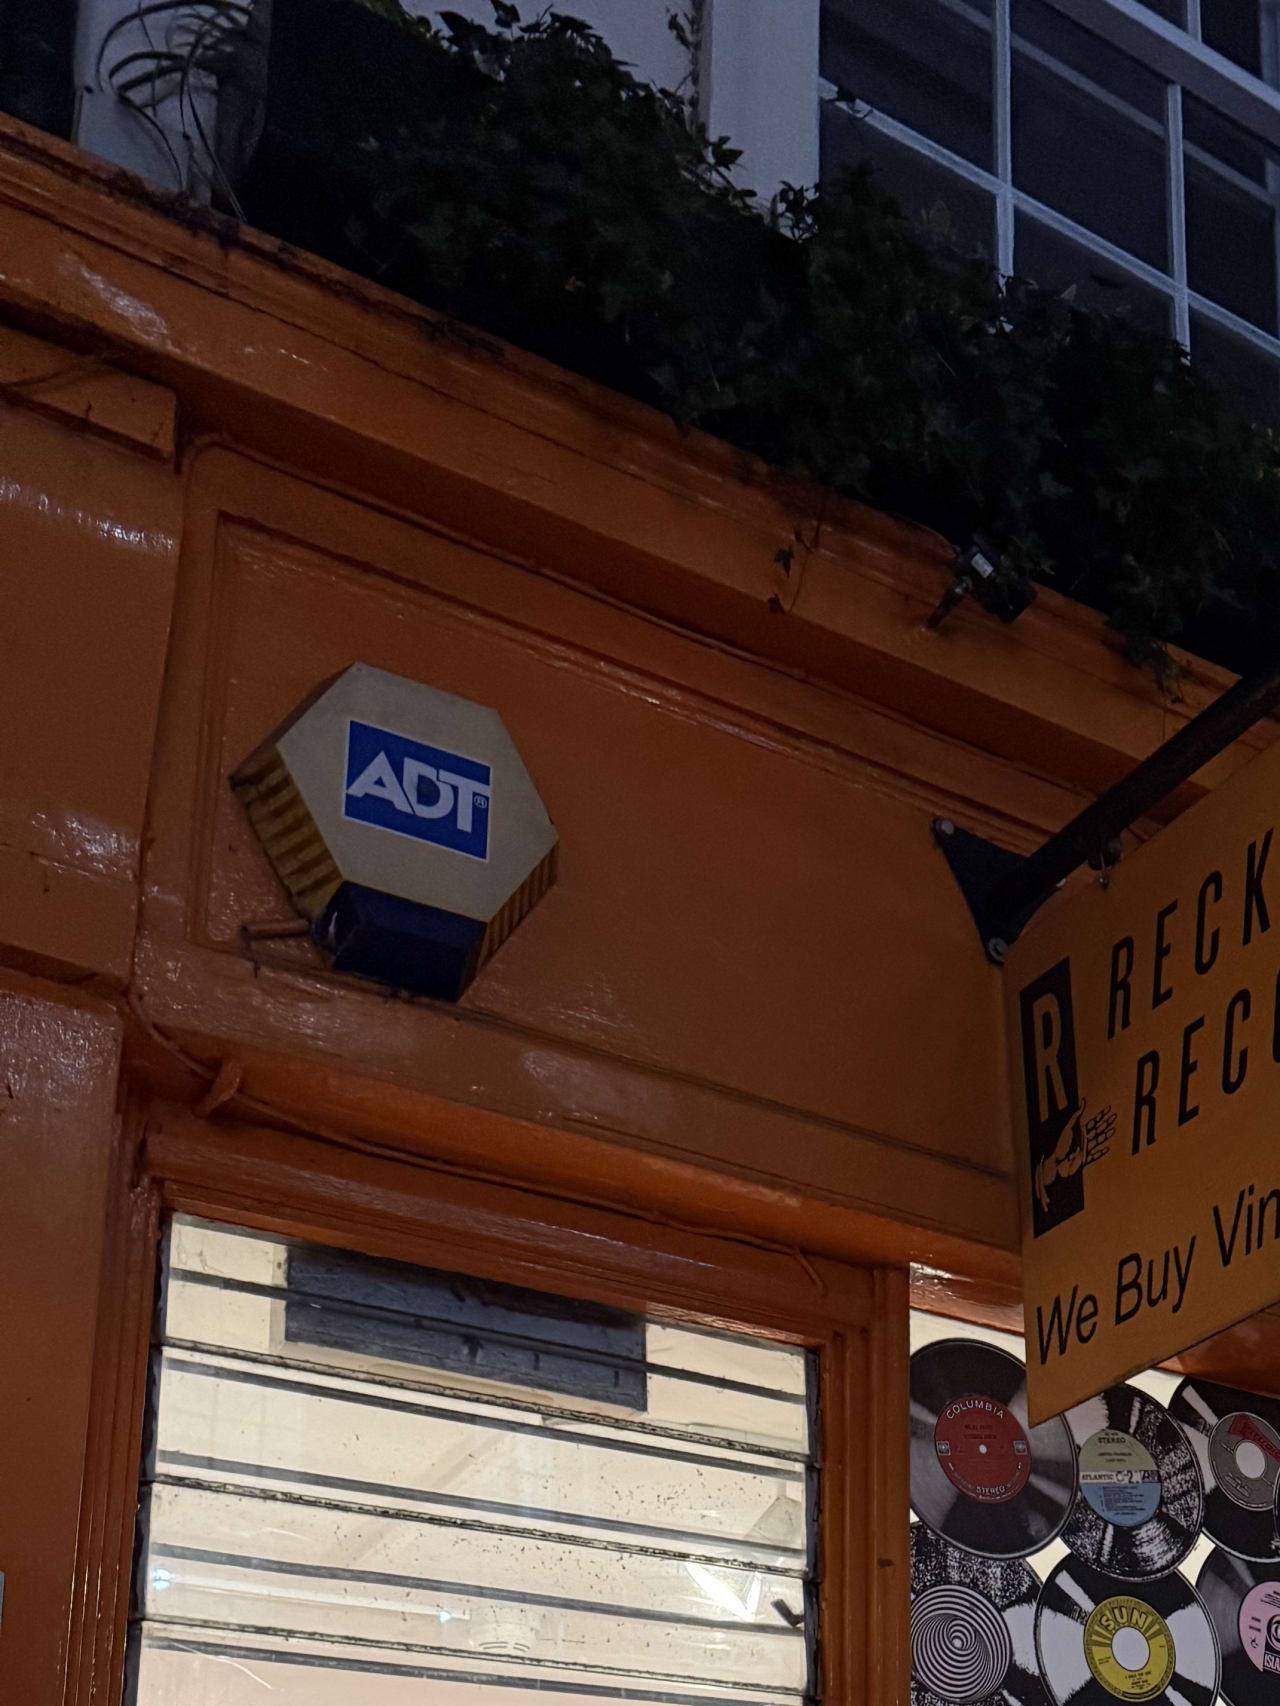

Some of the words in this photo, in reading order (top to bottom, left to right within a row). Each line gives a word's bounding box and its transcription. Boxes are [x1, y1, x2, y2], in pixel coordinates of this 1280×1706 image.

[1032, 990, 1068, 1124] R
[1036, 1284, 1099, 1366] We
[1114, 1233, 1197, 1326] Buy
[946, 1399, 1004, 1419] COLUMBIA
[1100, 1605, 1147, 1631] SUN
